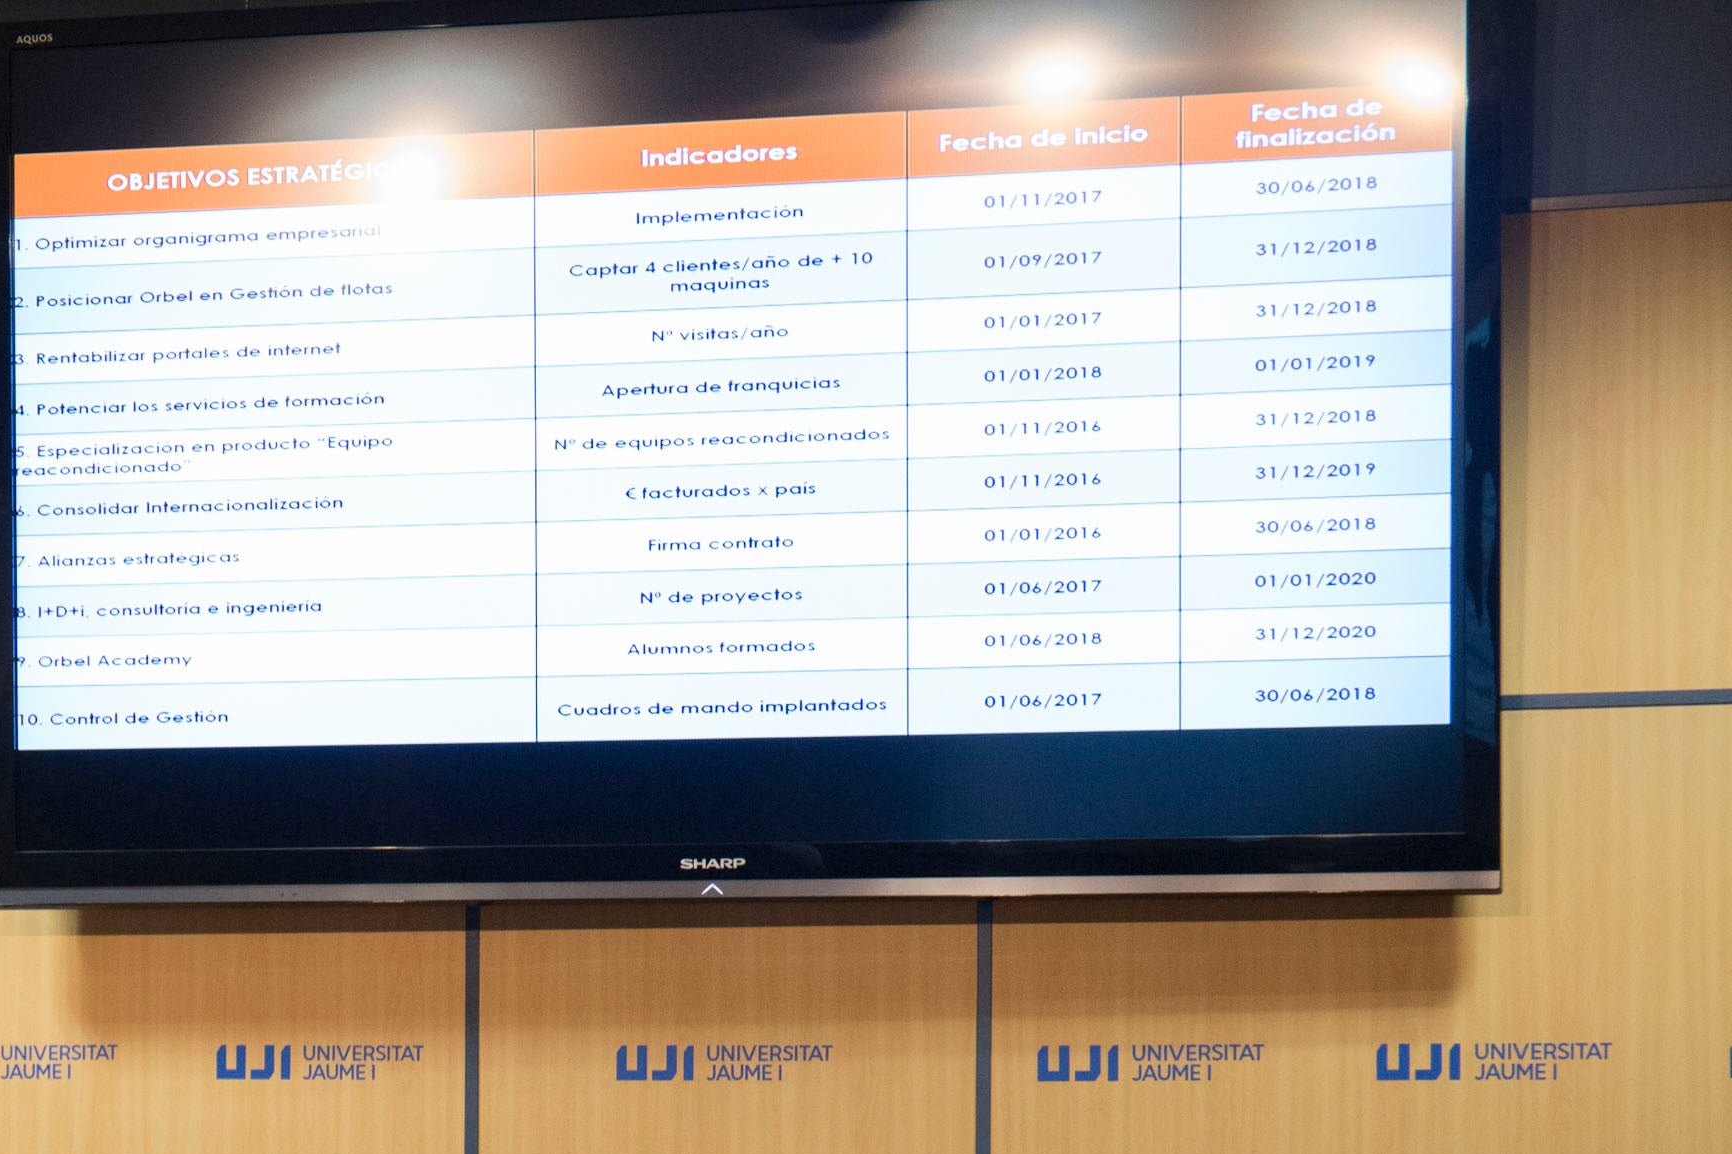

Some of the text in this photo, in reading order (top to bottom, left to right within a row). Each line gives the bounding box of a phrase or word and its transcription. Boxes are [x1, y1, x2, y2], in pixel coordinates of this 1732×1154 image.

[16, 33, 53, 45] AQUOS
[1252, 95, 1386, 122] Fecha de
[940, 122, 1148, 152] Fecha de inicio
[1236, 120, 1399, 148] finalización
[642, 145, 797, 167] Indicadores
[108, 158, 413, 191] OBJETIVOS ESTRATÉGIC
[1256, 176, 1377, 195] 30/06/2018
[983, 189, 1103, 209] 01/11/2017
[636, 207, 804, 227] Implementación
[35, 236, 126, 253] Optimizar
[133, 232, 259, 249] organigrama
[265, 227, 381, 243] empresarial
[1255, 237, 1378, 257] 31/12/2018
[569, 251, 873, 280] Captar 4 clientes/año de + 10
[983, 250, 1102, 270] 01/09/2017
[35, 295, 133, 308] Posicionar
[139, 290, 193, 304] Orbel
[199, 291, 223, 302] en
[229, 286, 303, 300] Gestión
[309, 284, 335, 297] de
[340, 282, 393, 296] flotas
[670, 279, 770, 294] maquinas
[1255, 299, 1377, 318] 31/12/2018
[983, 311, 1102, 329] 01/01/2017
[679, 324, 789, 341] visitas/año
[36, 350, 145, 365] Rentabilizar
[152, 347, 229, 365] portales
[236, 345, 261, 358] de
[268, 342, 341, 357] internet
[1254, 354, 1376, 373] 01/01/2019
[983, 365, 1102, 384] 01/01/2018
[601, 379, 841, 400] Apertura de franquicias
[36, 402, 127, 416] Potenciar
[132, 400, 159, 413] los
[165, 400, 247, 412] servicios
[253, 396, 279, 409] de
[284, 395, 385, 408] formación
[1255, 408, 1377, 427] 31/12/2018
[984, 420, 1101, 436] 01/11/2016
[37, 443, 185, 461] Especialización
[191, 443, 215, 453] en
[222, 437, 311, 455] producto
[581, 437, 608, 450] de
[614, 437, 695, 452] equipos
[701, 428, 890, 446] reacondicionados
[1255, 462, 1376, 481] 31/12/2019
[642, 484, 751, 500] facturados
[757, 486, 769, 496] x
[774, 480, 817, 499] país
[984, 472, 1102, 490] 01/11/2016
[37, 502, 139, 517] Consolidar
[146, 498, 343, 514] Internacionalización
[984, 526, 1102, 542] 01/01/2016
[1255, 517, 1377, 535] 30/06/2018
[648, 535, 794, 552] Firma contrato
[37, 555, 116, 567] Alianzas
[123, 552, 240, 567] estratégicas
[984, 579, 1102, 597] 01/06/2017
[1254, 571, 1377, 589] 01/01/2020
[667, 591, 694, 604] de
[701, 588, 803, 606] proyectos
[96, 603, 201, 617] consultoría
[207, 604, 219, 615] e
[226, 602, 322, 617] ingeniería
[984, 632, 1102, 648] 01/06/2018
[1255, 625, 1377, 642] 31/12/2020
[627, 639, 816, 655] Alumnos formados
[38, 655, 91, 668] Orbel
[97, 654, 192, 667] Academy
[984, 692, 1102, 710] 01/06/2017
[1255, 686, 1376, 704] 30/06/2018
[557, 697, 887, 717] Cuadros de mando implantados
[49, 712, 118, 726] Control
[124, 711, 150, 725] de
[156, 710, 229, 724] Gestión
[680, 858, 746, 869] SHARP
[0, 1043, 118, 1061] UNIVERSITAT
[303, 1044, 424, 1061] UNIVERSITAT
[707, 1044, 833, 1062] UNIVERSITAT
[1132, 1044, 1265, 1061] UNIVERSITAT
[1475, 1042, 1612, 1060] UNIVERSITAT
[1, 1063, 71, 1079] JAUME I
[216, 1044, 291, 1080] UJI
[616, 1045, 694, 1081] UJI
[1037, 1045, 1119, 1082] UJI
[1376, 1043, 1460, 1081] UJI
[303, 1064, 375, 1080] JAUME I
[707, 1064, 782, 1081] JAUME I
[1132, 1064, 1211, 1081] JAUME I
[1475, 1063, 1557, 1080] JAUME I
